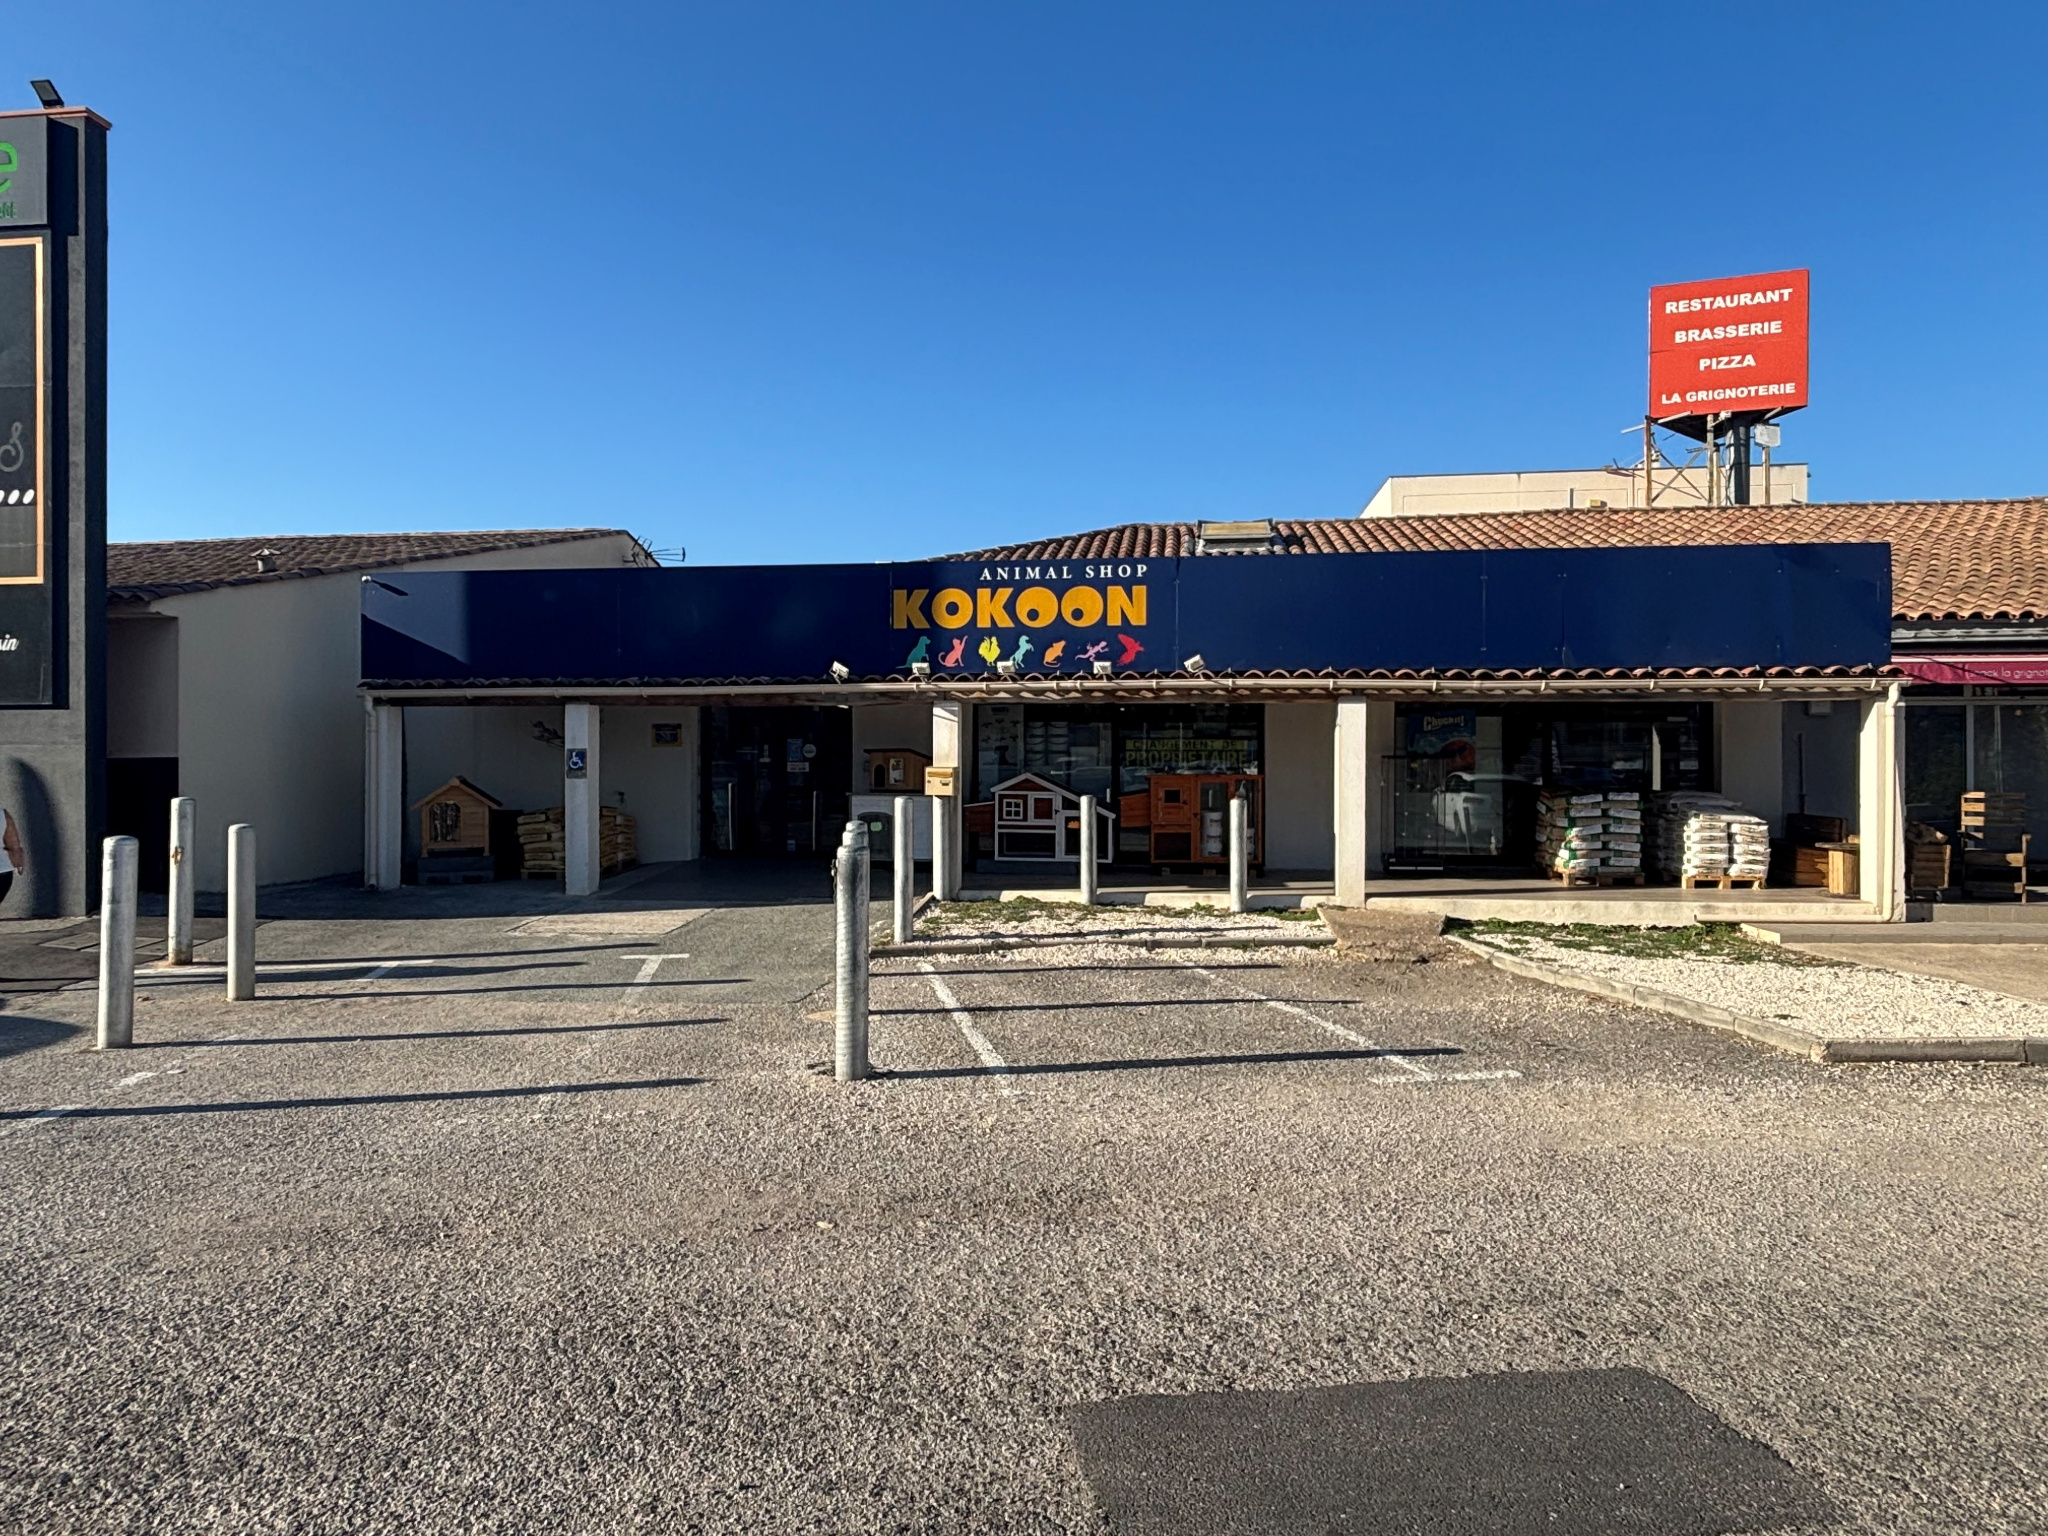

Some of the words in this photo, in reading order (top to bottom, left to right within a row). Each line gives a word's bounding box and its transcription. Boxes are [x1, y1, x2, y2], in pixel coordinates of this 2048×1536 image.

[1665, 288, 1793, 314] RESTAURANT
[1674, 320, 1783, 344] BRASSERIE
[1698, 354, 1756, 371] PIZZA
[1661, 392, 1682, 405] LA
[1685, 382, 1796, 403] GRIGNOTERIE
[980, 565, 1073, 581] ANIMAL
[1085, 564, 1149, 578] SHOP
[892, 584, 1148, 629] KOKOON
[1132, 740, 1215, 749] CHANGEMENT
[1222, 740, 1238, 749] DE
